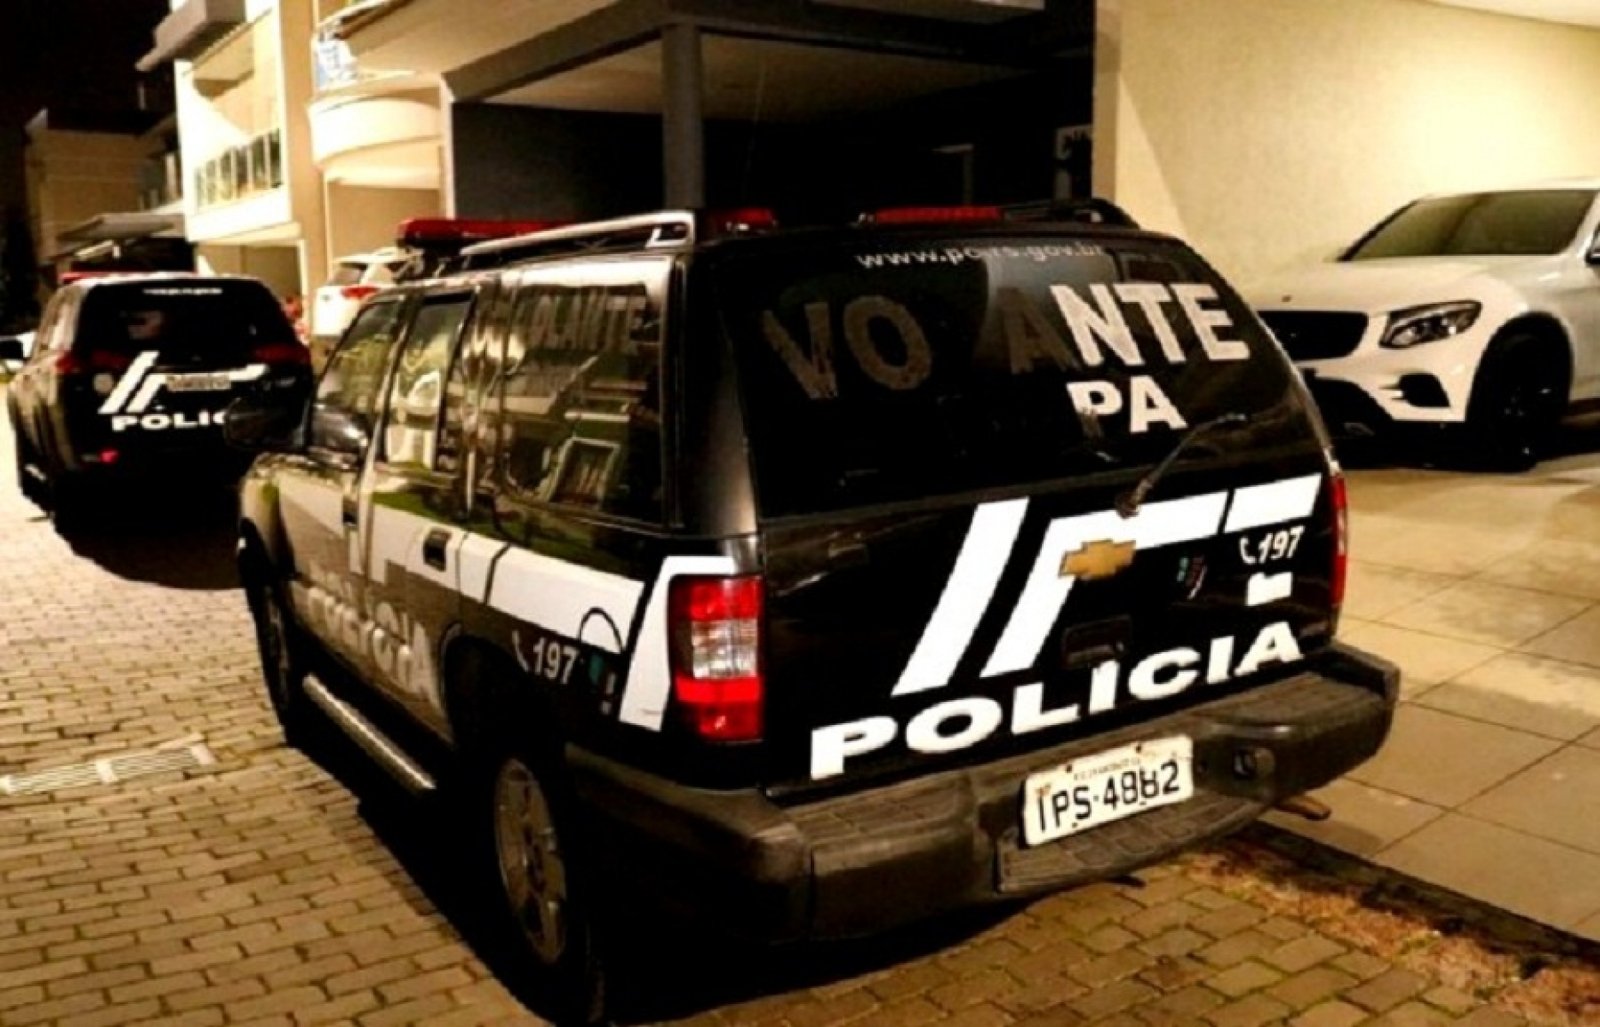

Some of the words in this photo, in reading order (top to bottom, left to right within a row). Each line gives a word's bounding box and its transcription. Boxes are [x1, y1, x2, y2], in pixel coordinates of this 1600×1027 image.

[1066, 374, 1188, 438] PA
[1257, 524, 1306, 565] 197
[532, 636, 580, 686] 197
[810, 621, 1304, 780] POLICIA
